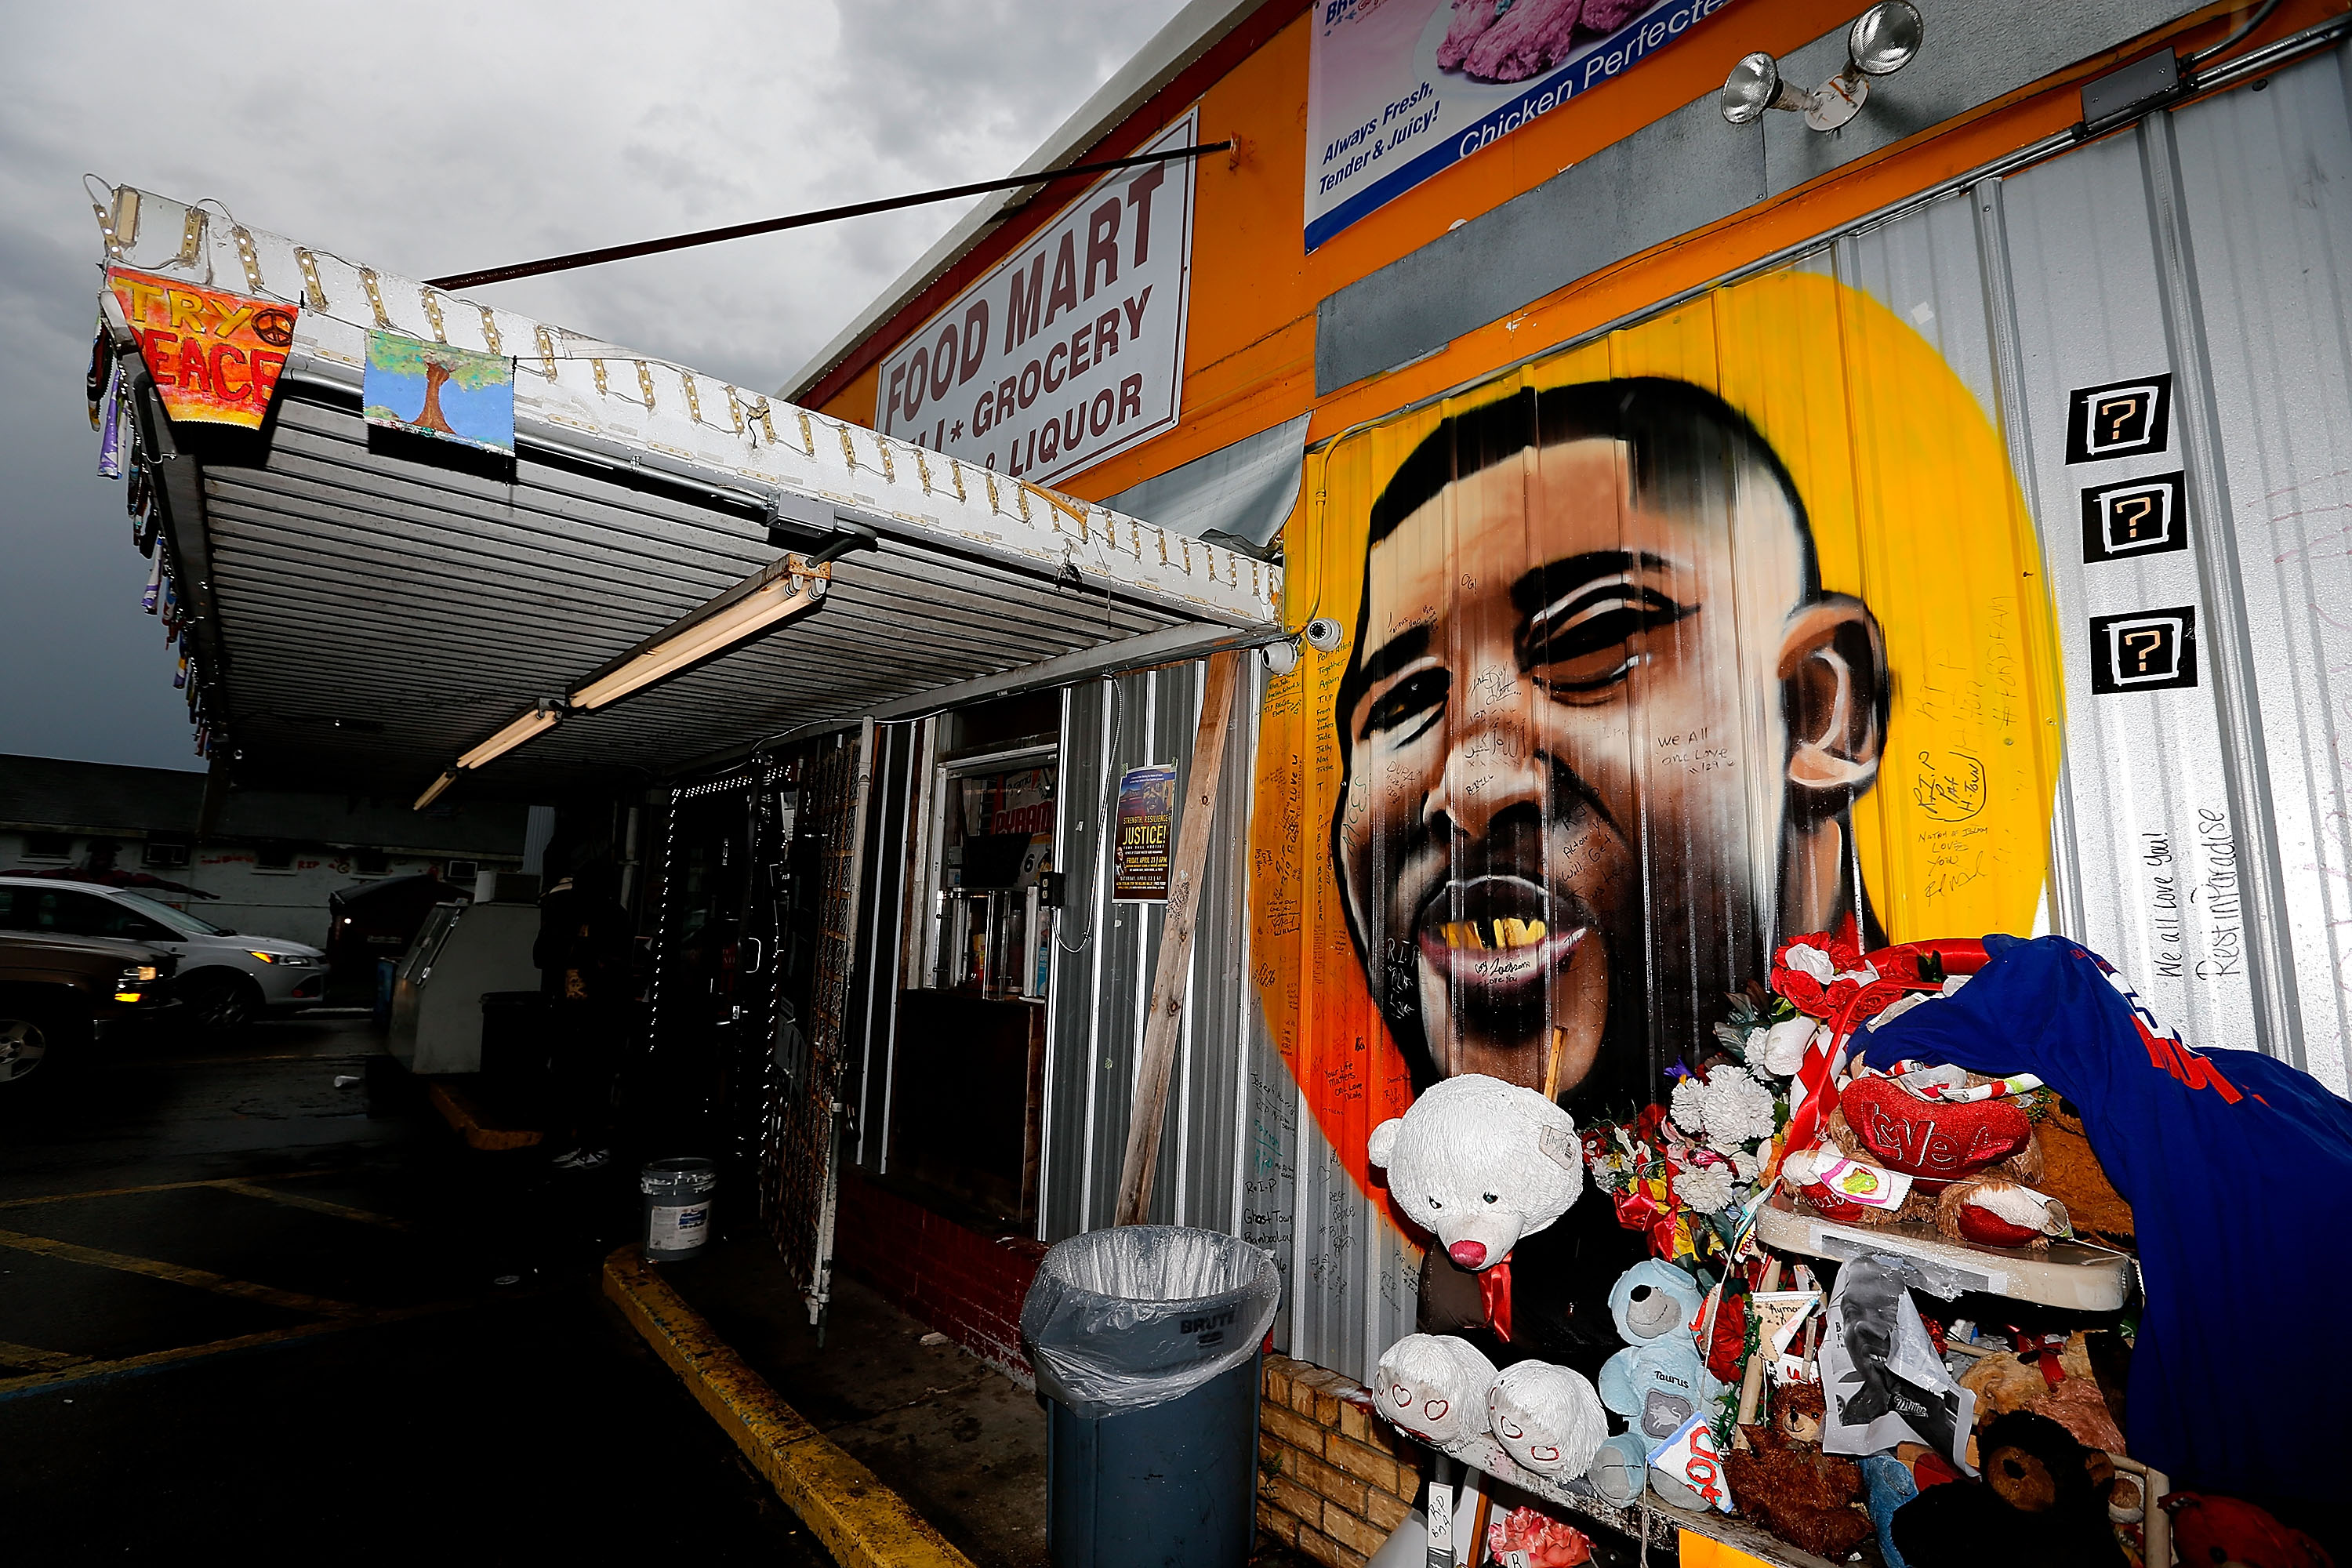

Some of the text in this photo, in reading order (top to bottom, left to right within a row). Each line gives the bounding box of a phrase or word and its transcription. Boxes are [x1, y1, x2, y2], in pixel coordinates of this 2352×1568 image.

[1322, 81, 1434, 166] Always Fresh,
[1459, 79, 1573, 159] Chicken
[1319, 100, 1440, 195] Tender & Juicy!
[112, 275, 255, 339] TRY
[885, 159, 1166, 436] FOOD MART
[129, 325, 287, 408] EACE
[971, 283, 1154, 439] GROCERY
[1009, 372, 1143, 477] LIQUOR
[1319, 677, 1340, 691] Again
[1316, 732, 1332, 742] Jade
[1657, 727, 1708, 748] We All
[1122, 825, 1167, 845] JUSTICE!
[2154, 918, 2180, 942] all
[2154, 952, 2183, 977] We
[1324, 1068, 1339, 1080] Your
[1328, 1072, 1356, 1088] Matters
[1654, 1370, 1690, 1390] Taurus
[1893, 1395, 1930, 1419] Miller
